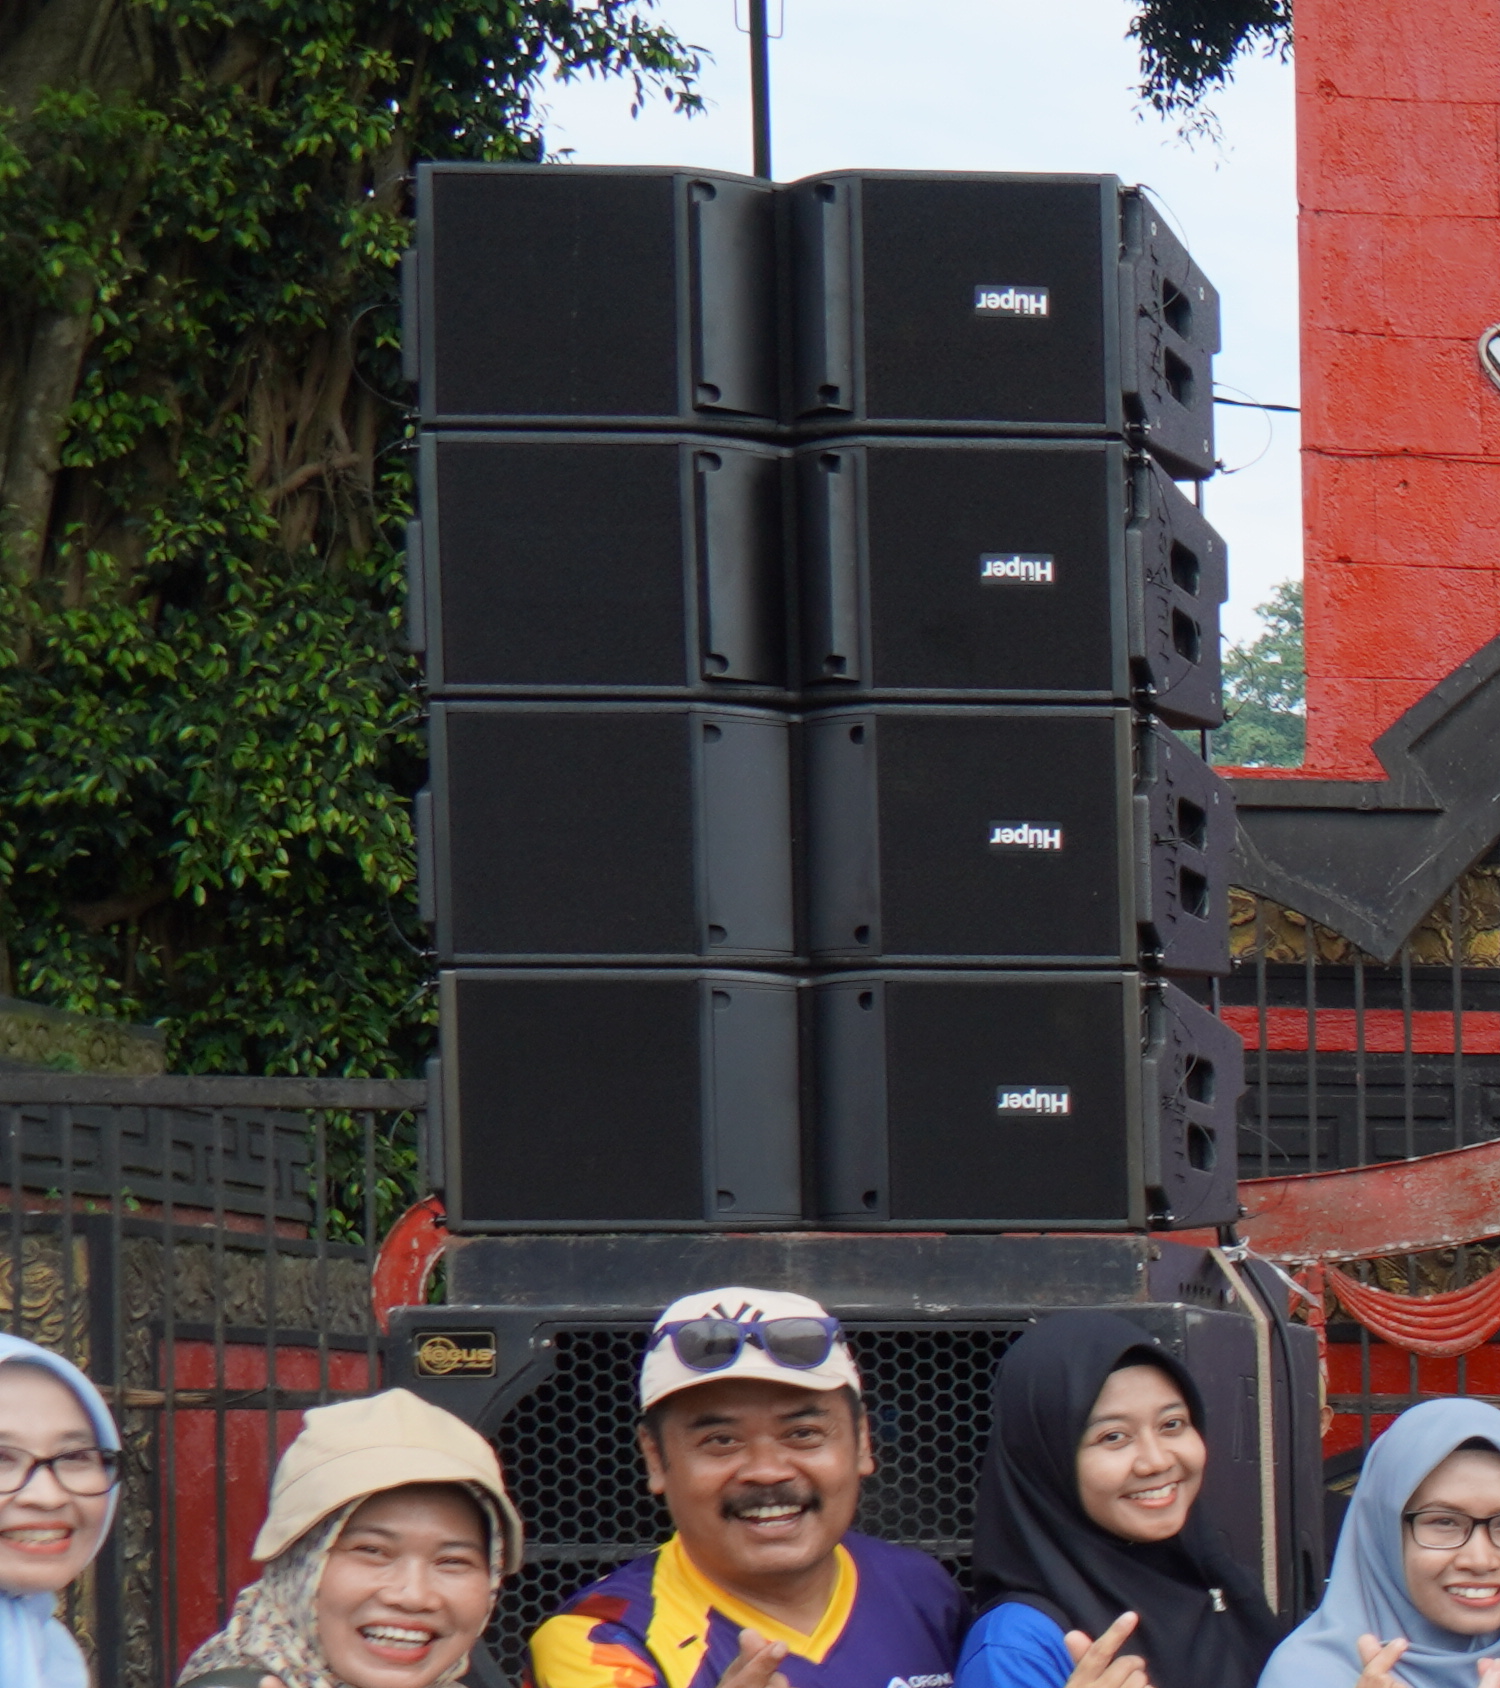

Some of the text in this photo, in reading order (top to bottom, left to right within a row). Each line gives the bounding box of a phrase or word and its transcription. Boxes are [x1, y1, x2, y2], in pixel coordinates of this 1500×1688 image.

[976, 288, 1047, 314] Hüper
[981, 555, 1052, 581] Hüper
[990, 823, 1060, 849] Hüper
[998, 1088, 1068, 1113] Hüper
